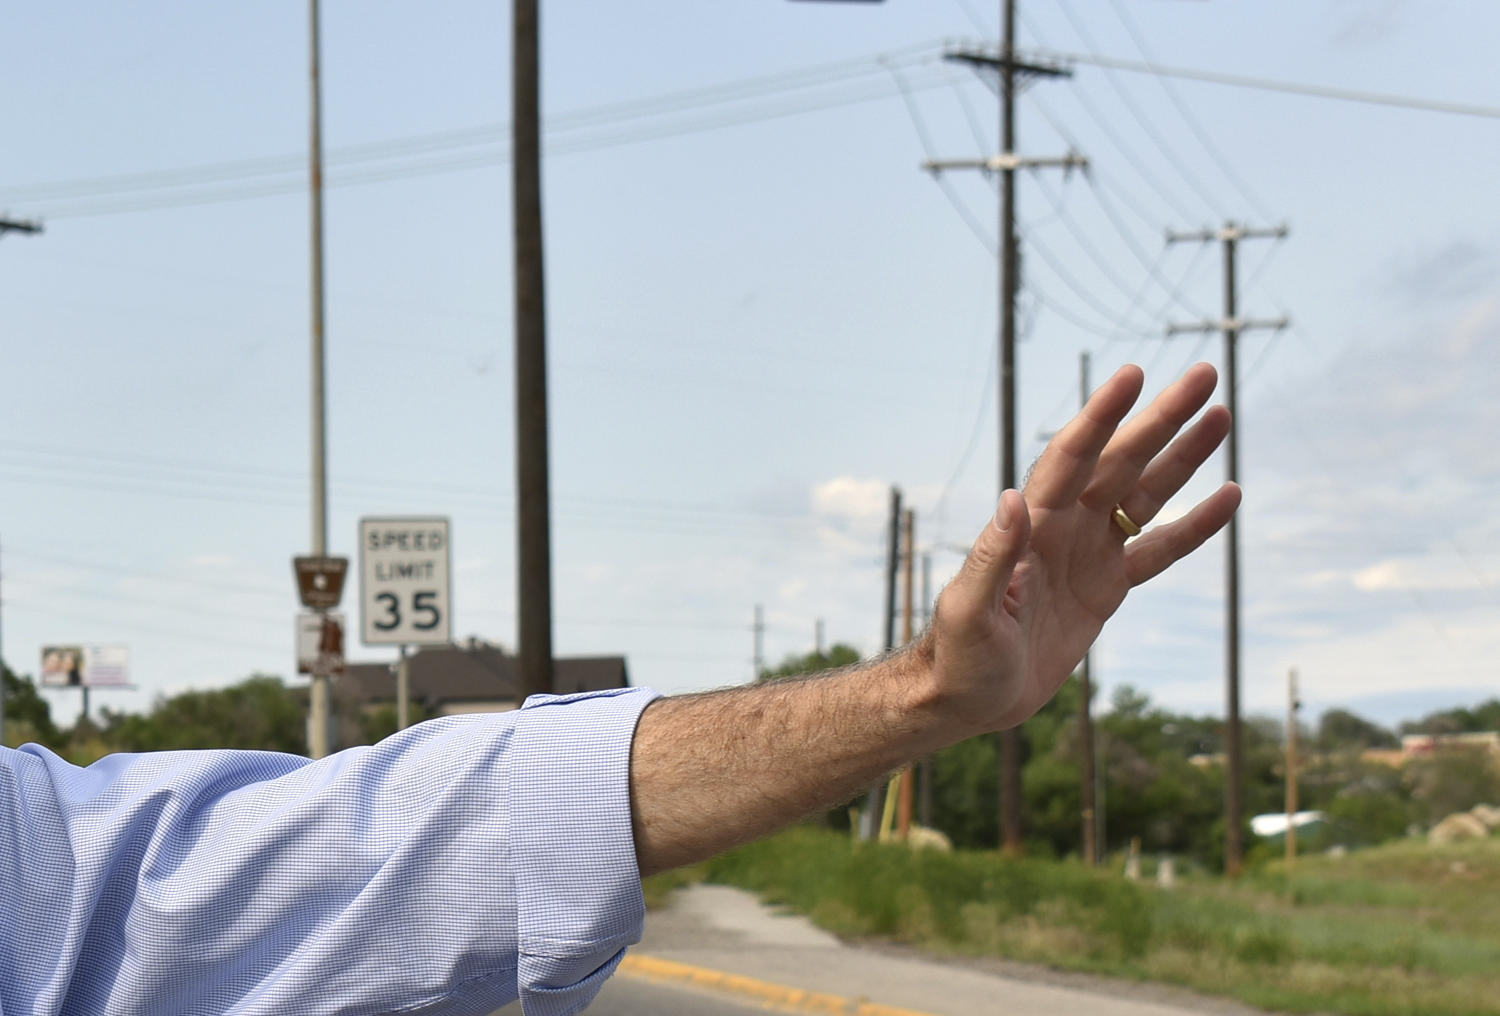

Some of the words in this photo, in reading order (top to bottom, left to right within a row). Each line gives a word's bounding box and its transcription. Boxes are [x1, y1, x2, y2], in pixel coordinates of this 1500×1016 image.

[368, 529, 443, 551] SPEED
[376, 562, 434, 582] LIMIT
[373, 592, 441, 631] 35
